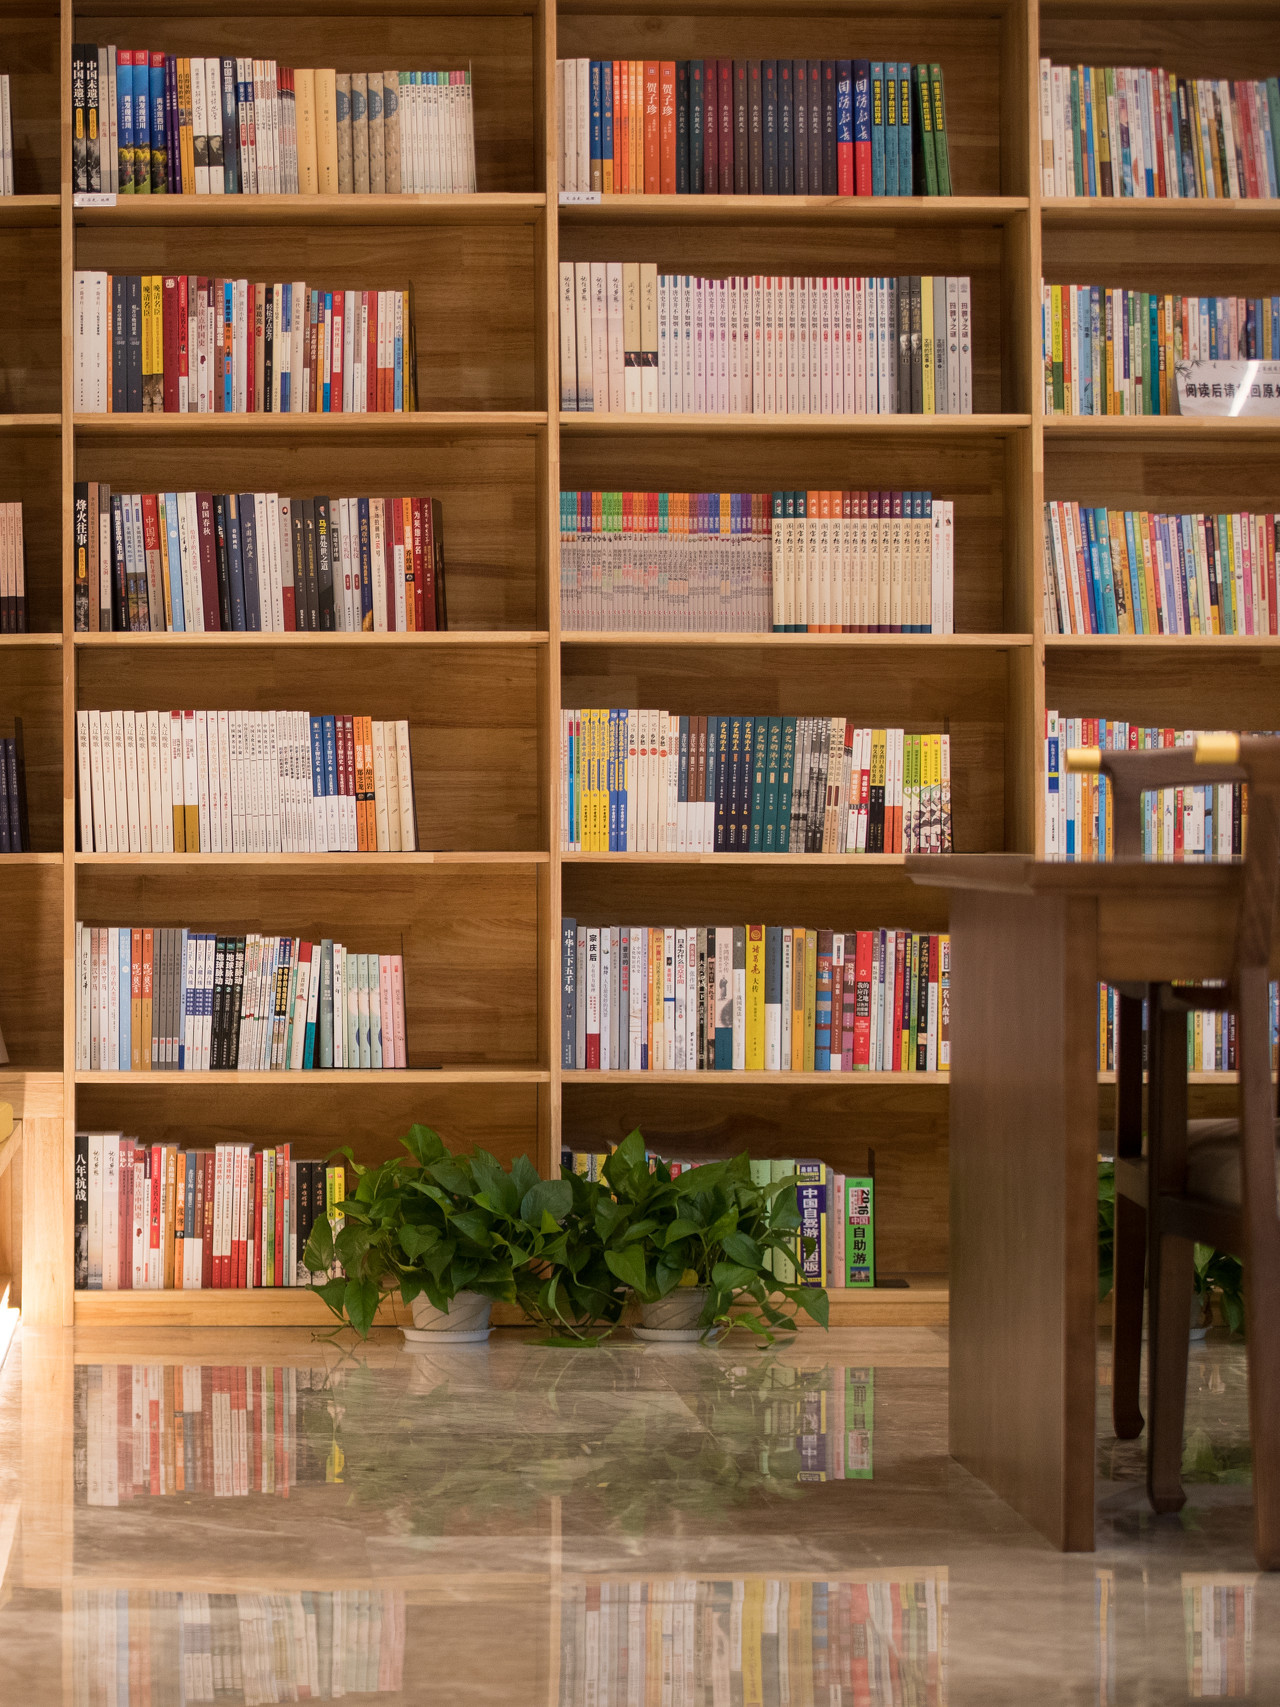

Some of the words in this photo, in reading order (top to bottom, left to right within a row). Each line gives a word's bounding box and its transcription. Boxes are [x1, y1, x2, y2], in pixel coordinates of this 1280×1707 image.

[646, 82, 657, 115] 贺子珍
[662, 84, 673, 116] 贺子珍
[838, 80, 850, 141] 国防部长
[855, 78, 868, 141] 国防部长
[1185, 383, 1280, 398] 阅读后请回原
[76, 499, 87, 546] 烽火往事
[145, 516, 155, 549] 中国梦
[201, 501, 211, 536] 鲁国春秋
[564, 929, 574, 993] 中华上下五千年
[589, 934, 597, 962] 宗庆后
[942, 989, 950, 1025] 名人故事
[75, 1154, 87, 1202] 八年抗战
[858, 1189, 870, 1215] 2016
[851, 1217, 869, 1225] 中国
[852, 1227, 867, 1265] 自助游
